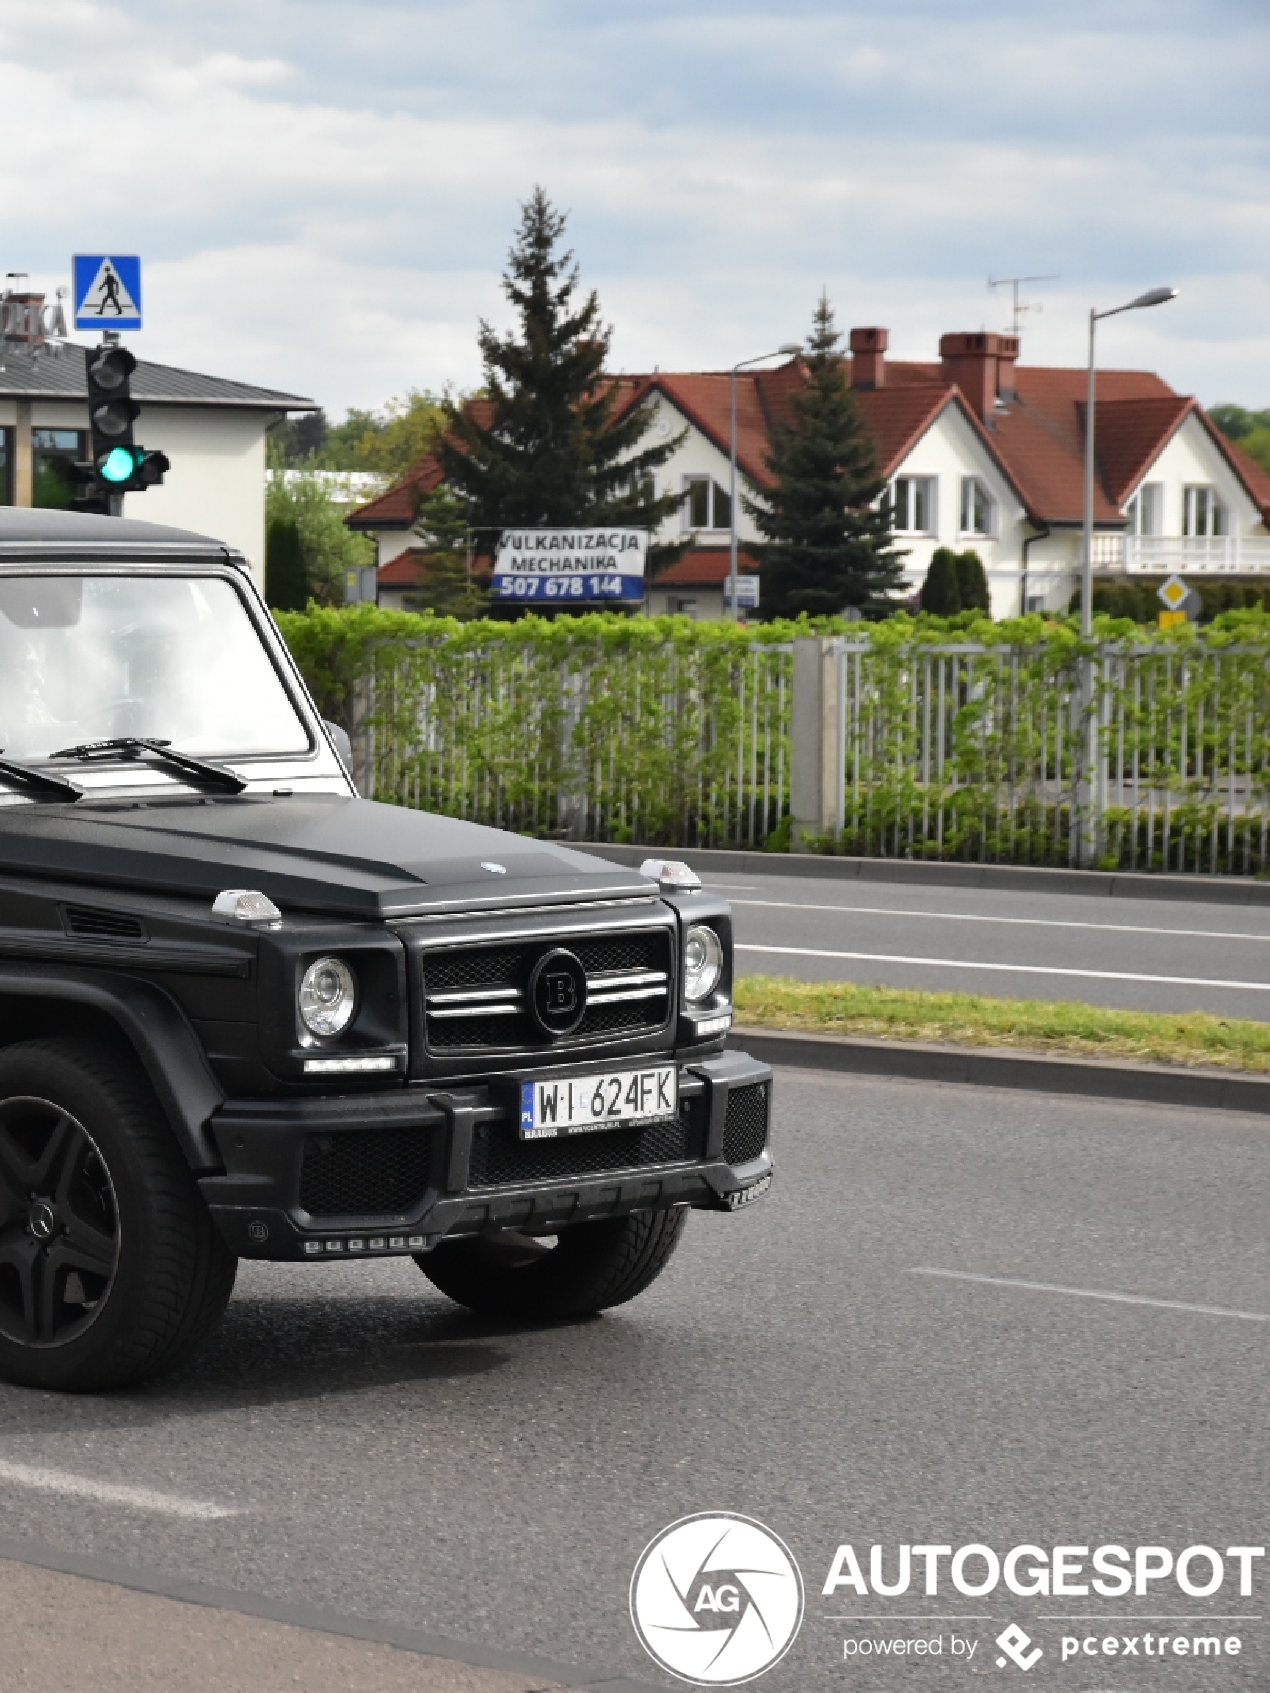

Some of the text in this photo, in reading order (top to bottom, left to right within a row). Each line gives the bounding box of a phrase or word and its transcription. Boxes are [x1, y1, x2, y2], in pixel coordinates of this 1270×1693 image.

[499, 534, 639, 552] VULKANIZACJA
[511, 555, 618, 572] MECHANIKA
[501, 577, 540, 595] 507
[545, 578, 583, 597] 678
[539, 1070, 672, 1124] WI 624FK
[522, 1111, 533, 1123] PL
